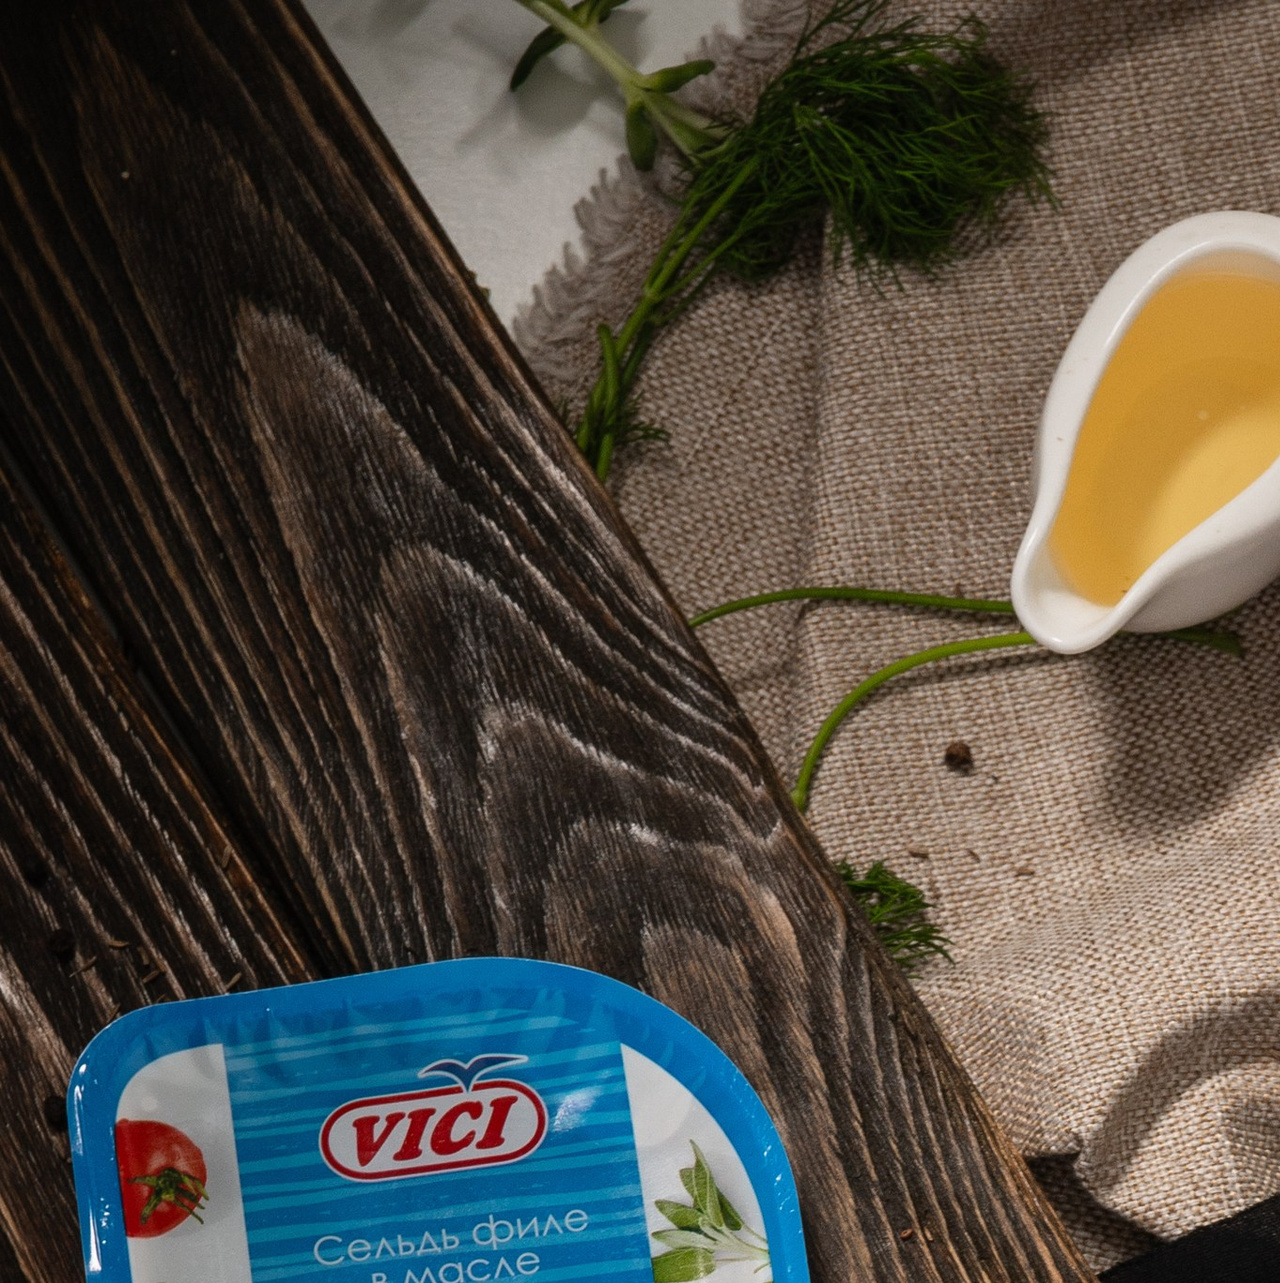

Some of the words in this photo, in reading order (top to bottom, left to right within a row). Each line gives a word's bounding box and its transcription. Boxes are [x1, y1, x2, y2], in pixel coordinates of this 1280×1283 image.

[351, 1095, 519, 1168] VICI
[313, 1228, 460, 1267] Сельдь
[472, 1208, 590, 1250] филе
